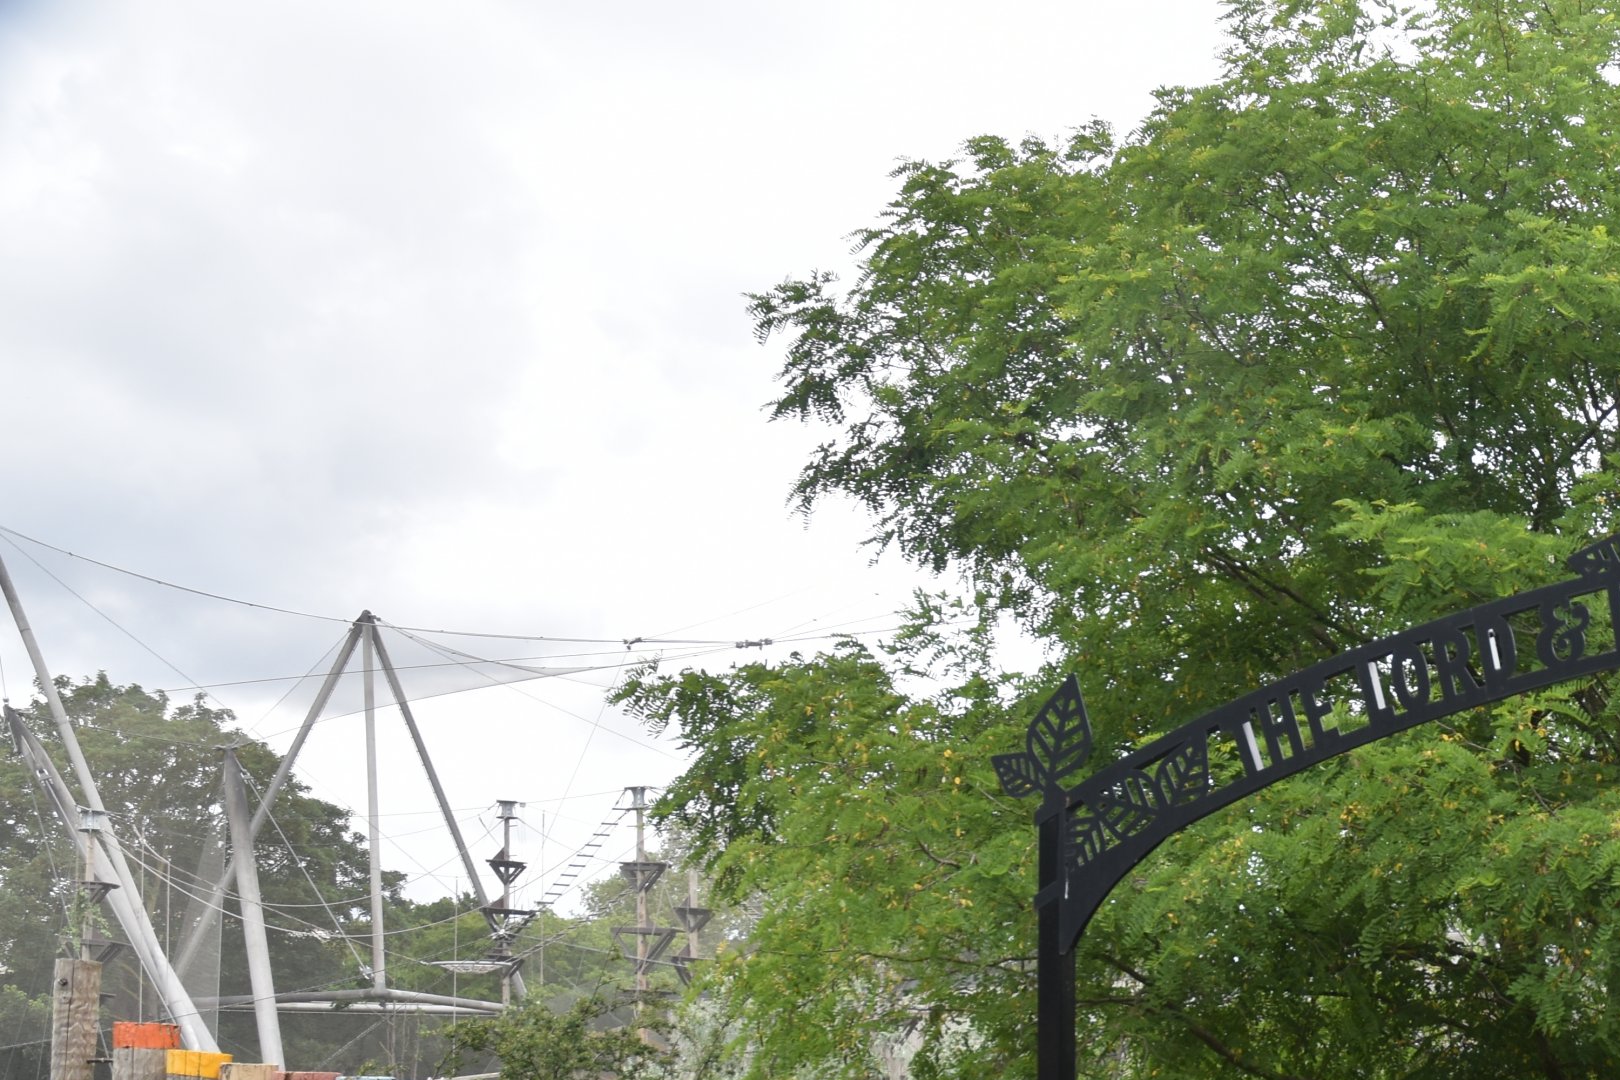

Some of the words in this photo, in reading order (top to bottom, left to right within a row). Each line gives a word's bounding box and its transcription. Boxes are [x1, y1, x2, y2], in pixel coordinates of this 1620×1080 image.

[1218, 676, 1341, 780] THE
[1356, 614, 1516, 728] LORD
[1536, 594, 1590, 664] &
